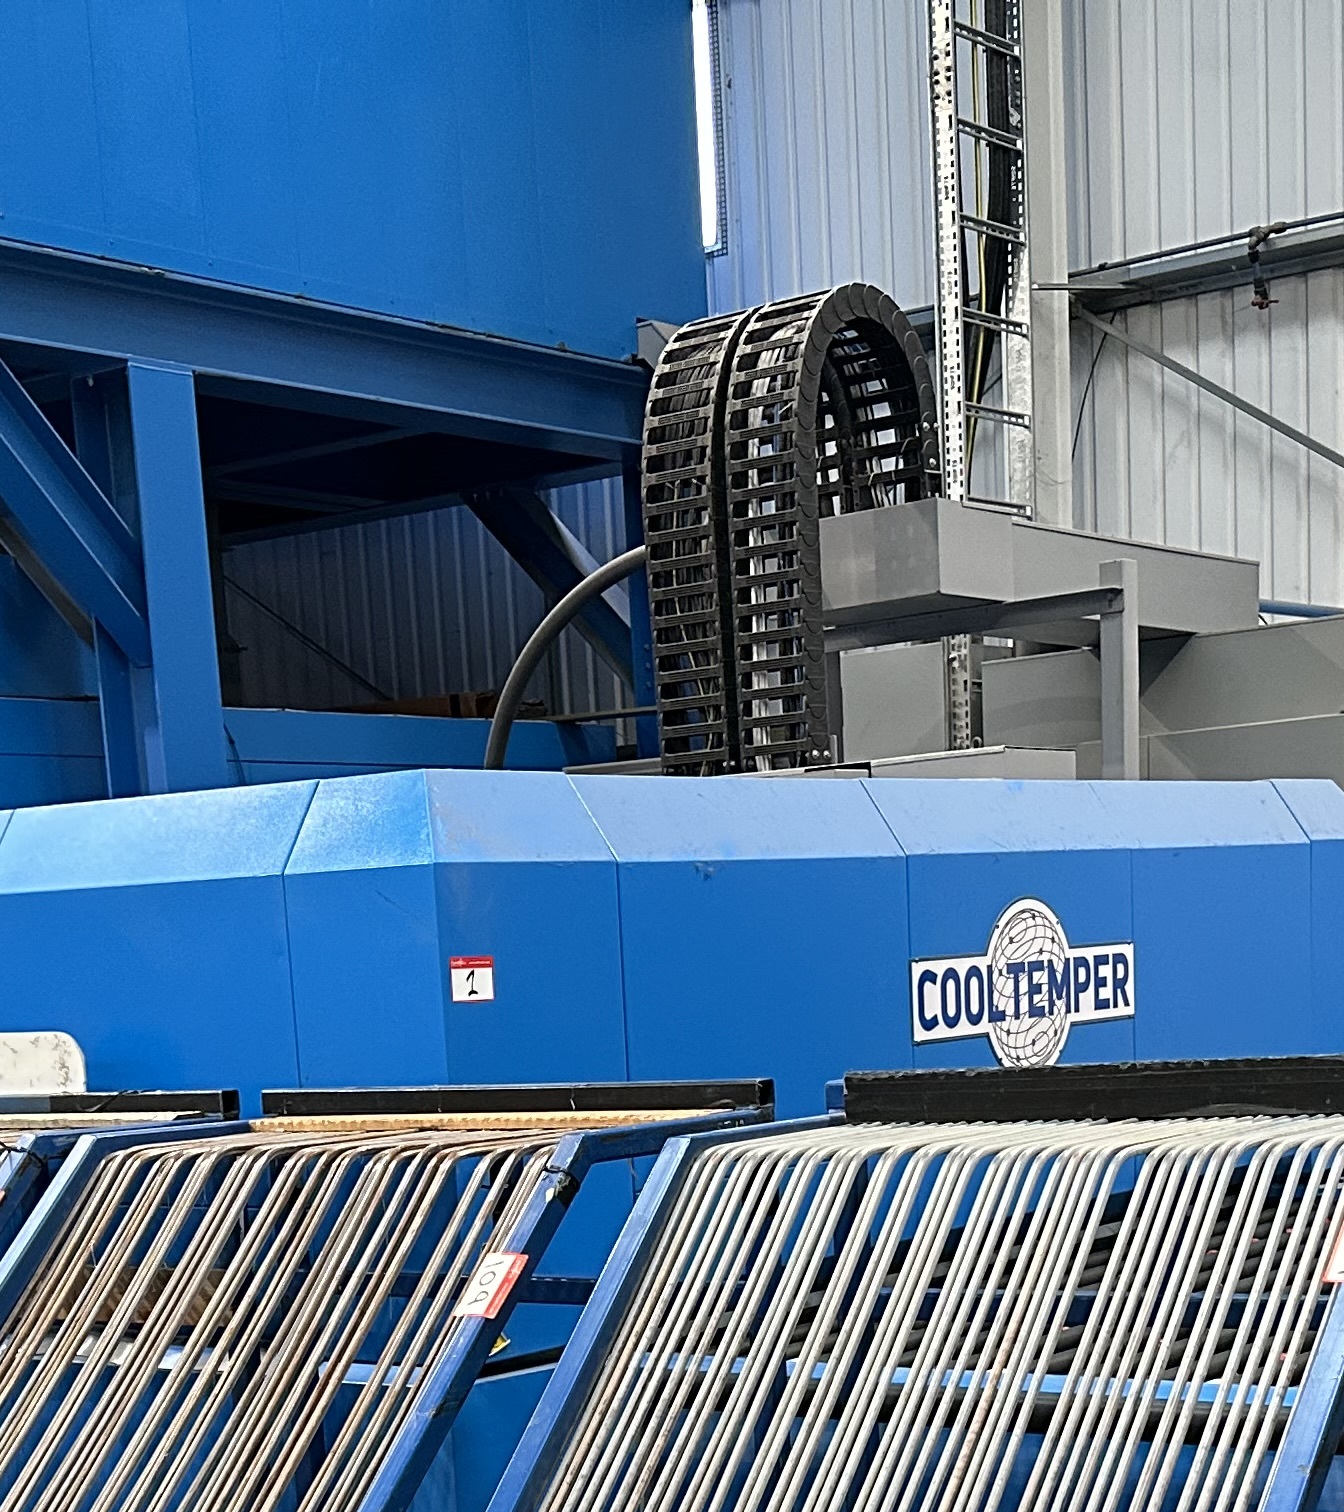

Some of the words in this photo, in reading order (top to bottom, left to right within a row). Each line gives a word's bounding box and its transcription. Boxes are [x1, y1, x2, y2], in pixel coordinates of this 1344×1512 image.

[466, 969, 479, 997] 1
[917, 952, 1131, 1032] COOLTEMPER
[467, 1260, 505, 1306] 109
